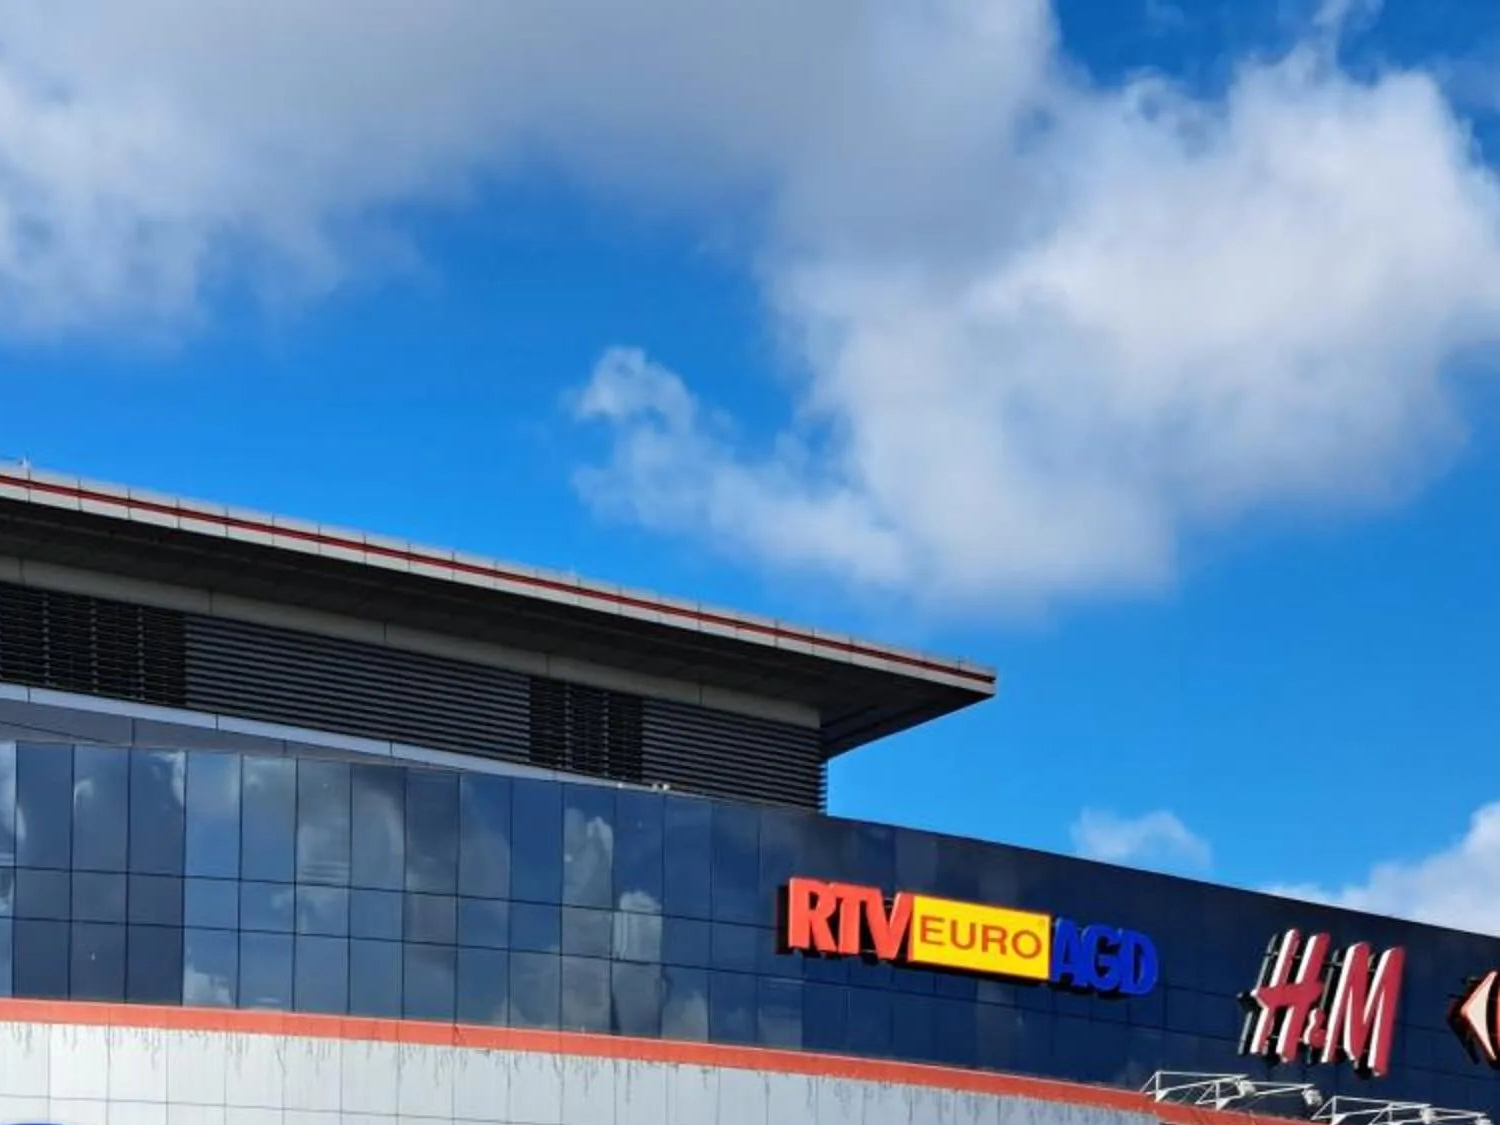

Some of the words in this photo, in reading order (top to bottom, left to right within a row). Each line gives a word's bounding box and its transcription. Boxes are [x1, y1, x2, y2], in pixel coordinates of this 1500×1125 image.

[788, 876, 914, 961] RTV
[919, 914, 1043, 960] EURO
[1051, 916, 1159, 995] AGD
[1250, 929, 1405, 1077] H&M
